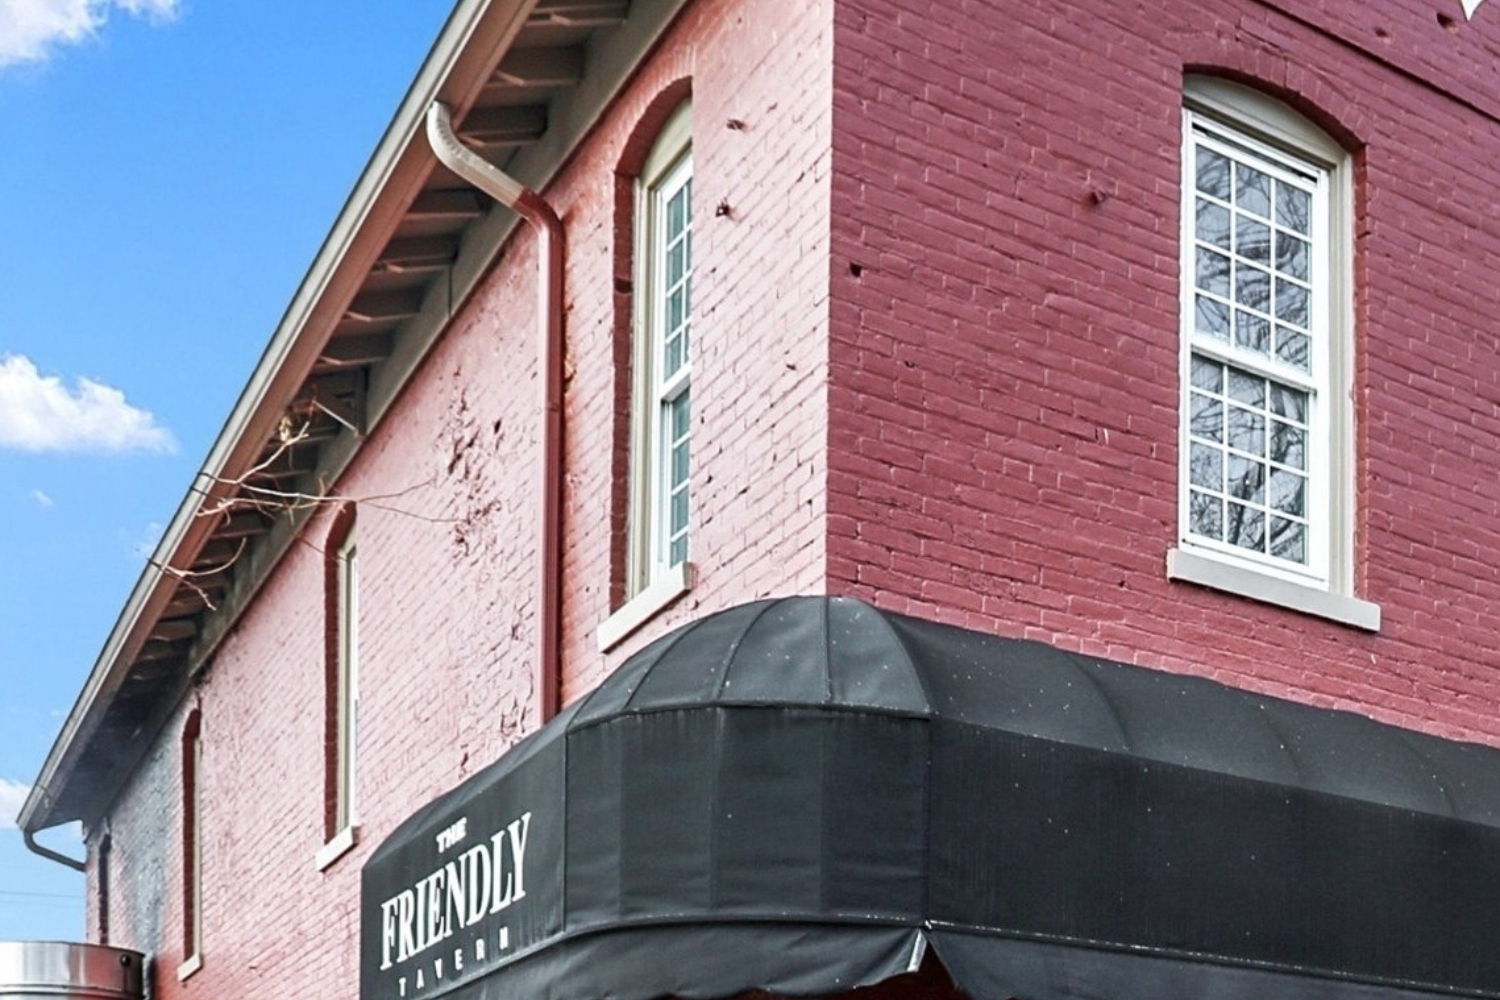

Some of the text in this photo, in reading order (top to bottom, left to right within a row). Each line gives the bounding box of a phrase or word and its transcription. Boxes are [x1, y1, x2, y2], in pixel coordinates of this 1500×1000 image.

[435, 816, 467, 853] THE
[380, 812, 532, 971] FRIENDLY
[398, 926, 509, 997] TAVERN
